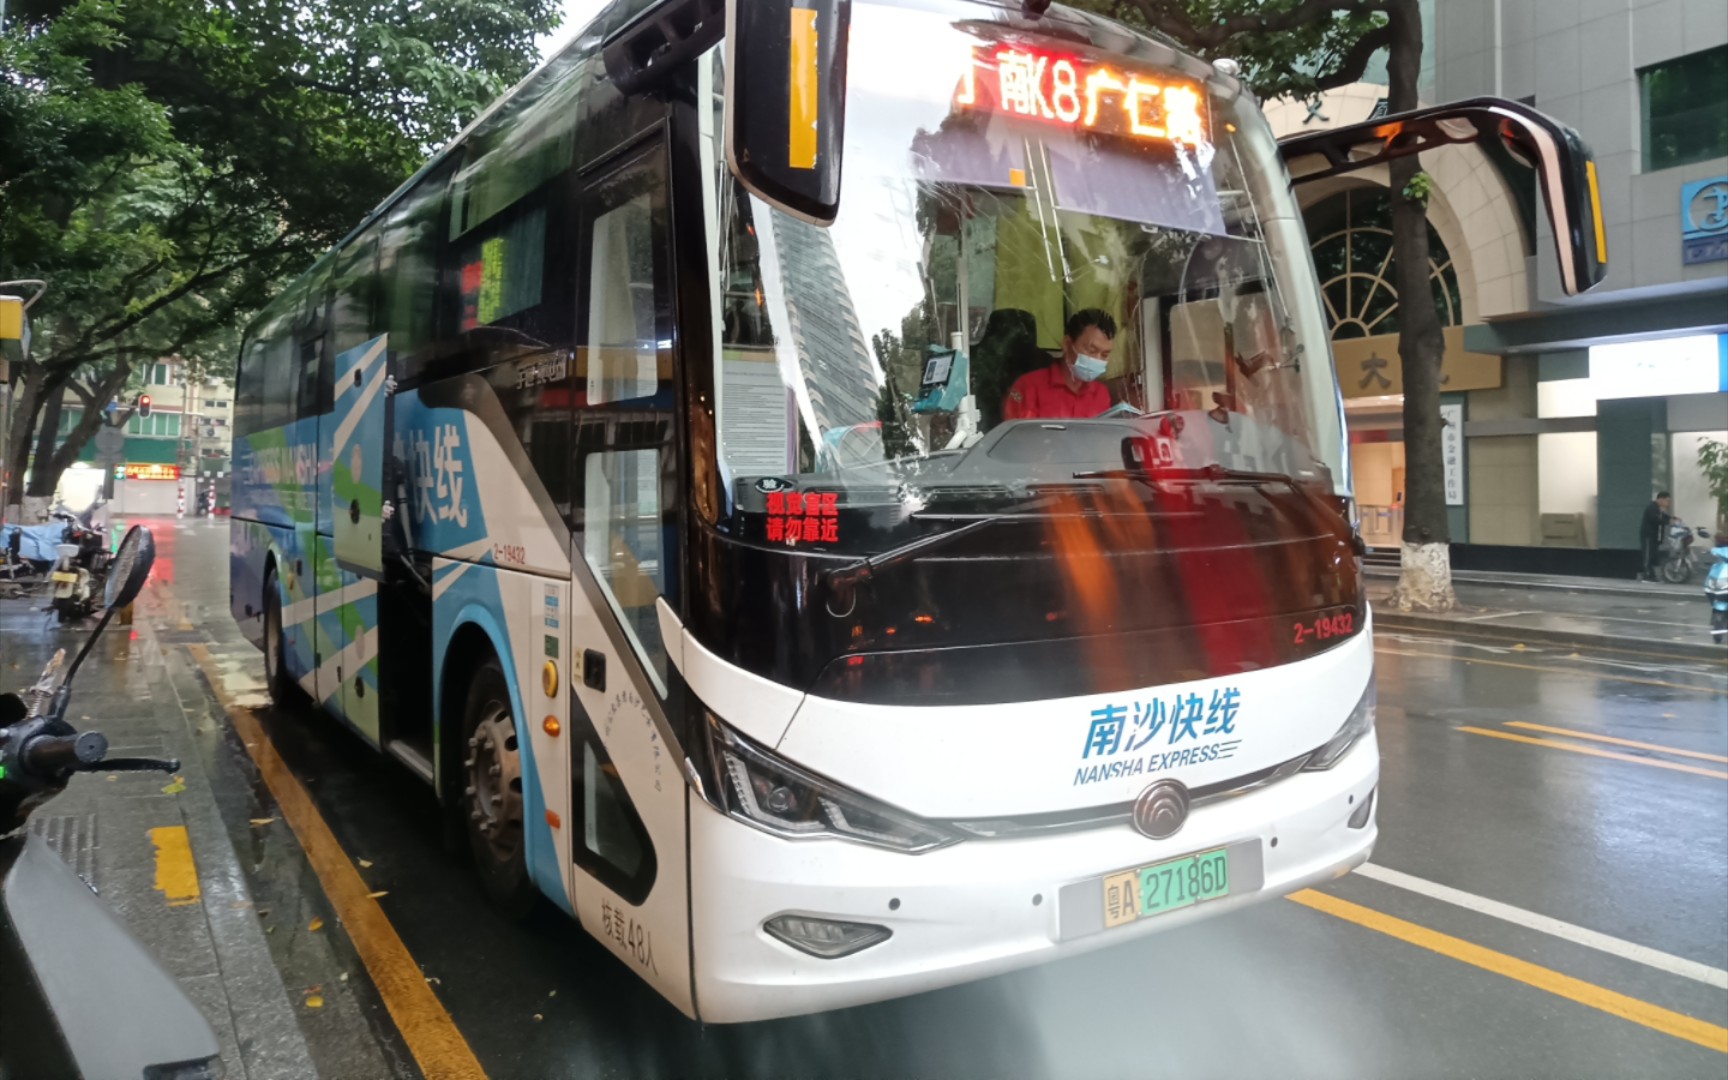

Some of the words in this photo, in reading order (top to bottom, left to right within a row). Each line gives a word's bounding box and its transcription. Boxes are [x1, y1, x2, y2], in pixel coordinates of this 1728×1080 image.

[766, 516, 839, 543] 请勿靠近
[493, 543, 526, 565] 2-19432
[1293, 612, 1353, 644] 2-19432
[1081, 687, 1241, 760] 南沙快线
[1073, 757, 1143, 786] NANSHA
[1147, 743, 1221, 773] EXPRESS
